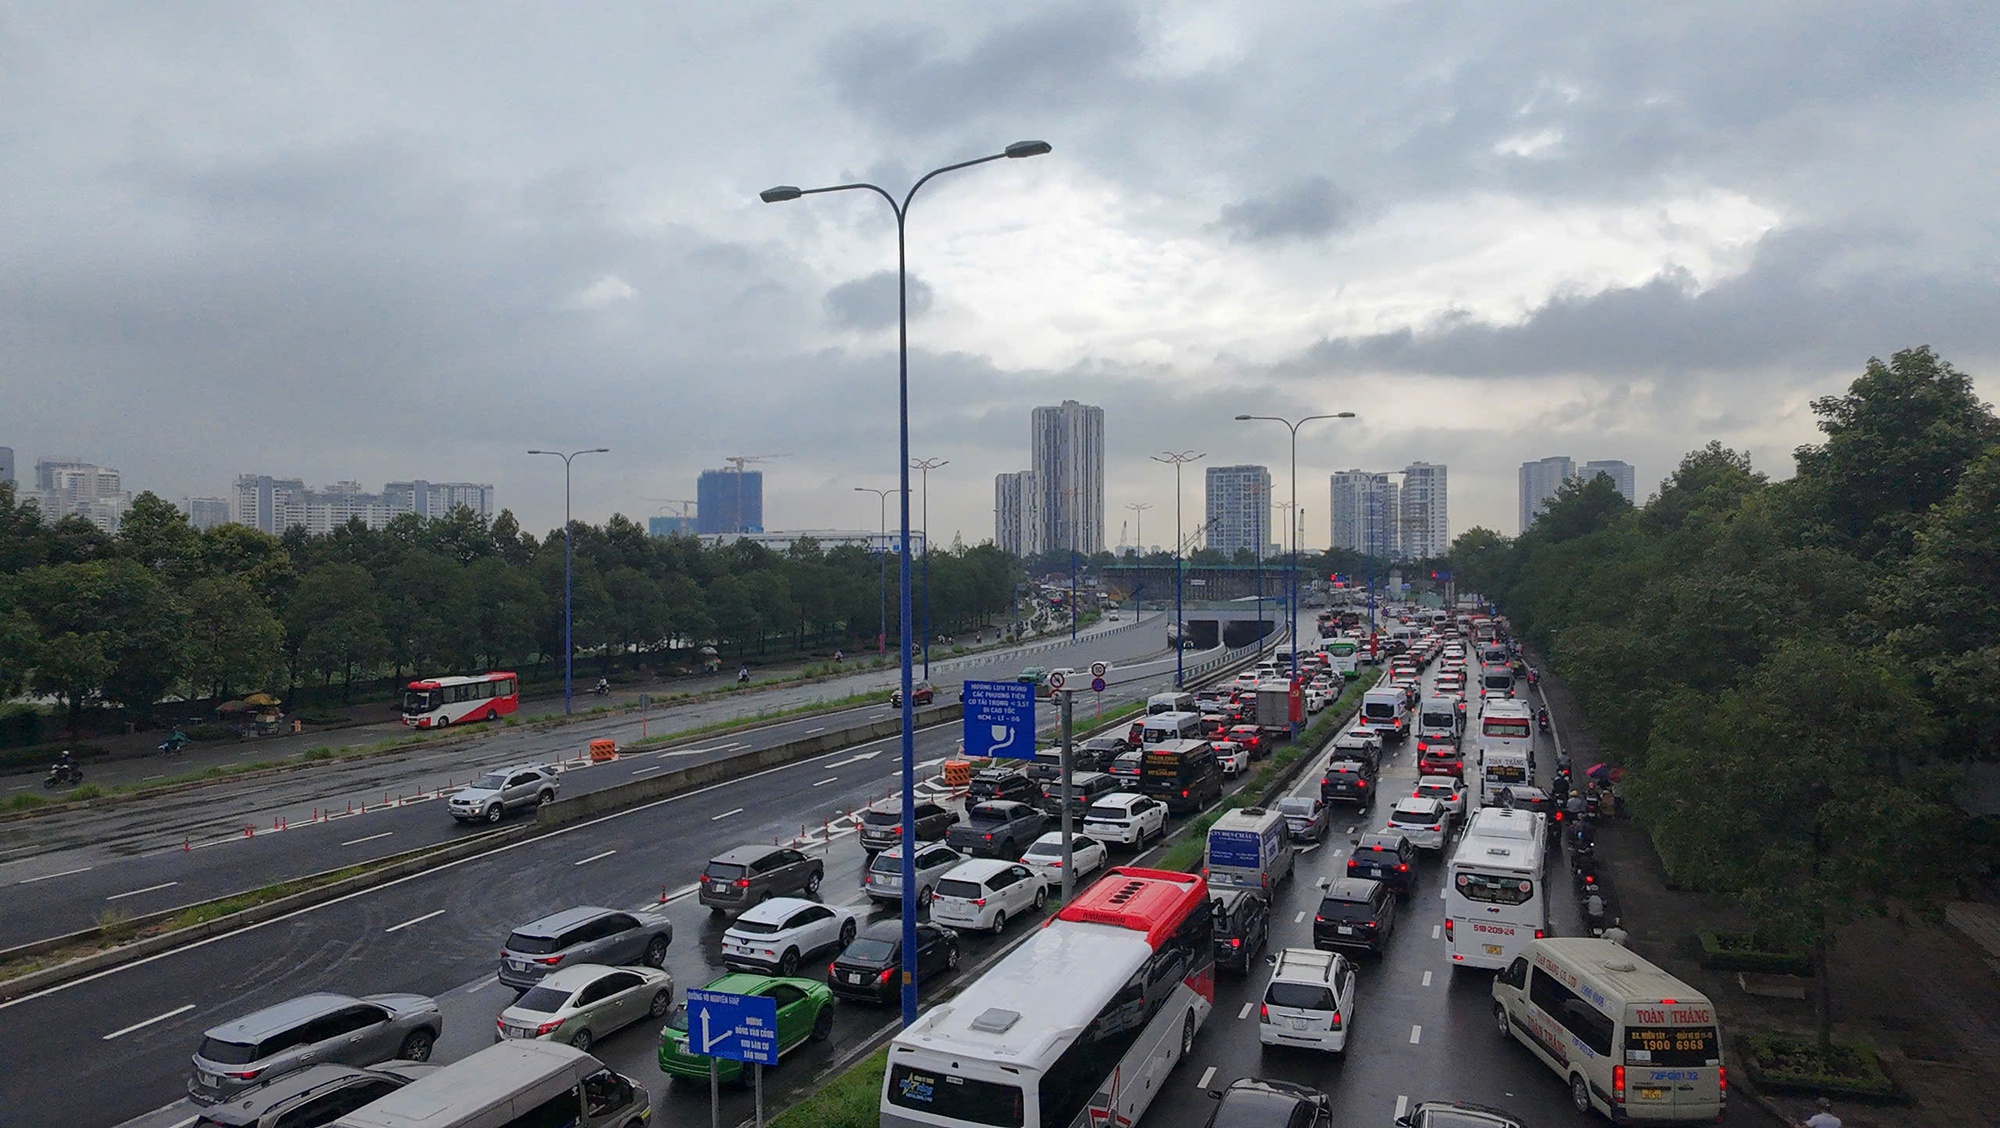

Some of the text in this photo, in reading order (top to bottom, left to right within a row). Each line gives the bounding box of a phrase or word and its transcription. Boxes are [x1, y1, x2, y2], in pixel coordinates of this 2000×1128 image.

[1636, 1006, 1710, 1024] TOÀN THẮNG
[1643, 1040, 1704, 1051] 1900 6968
